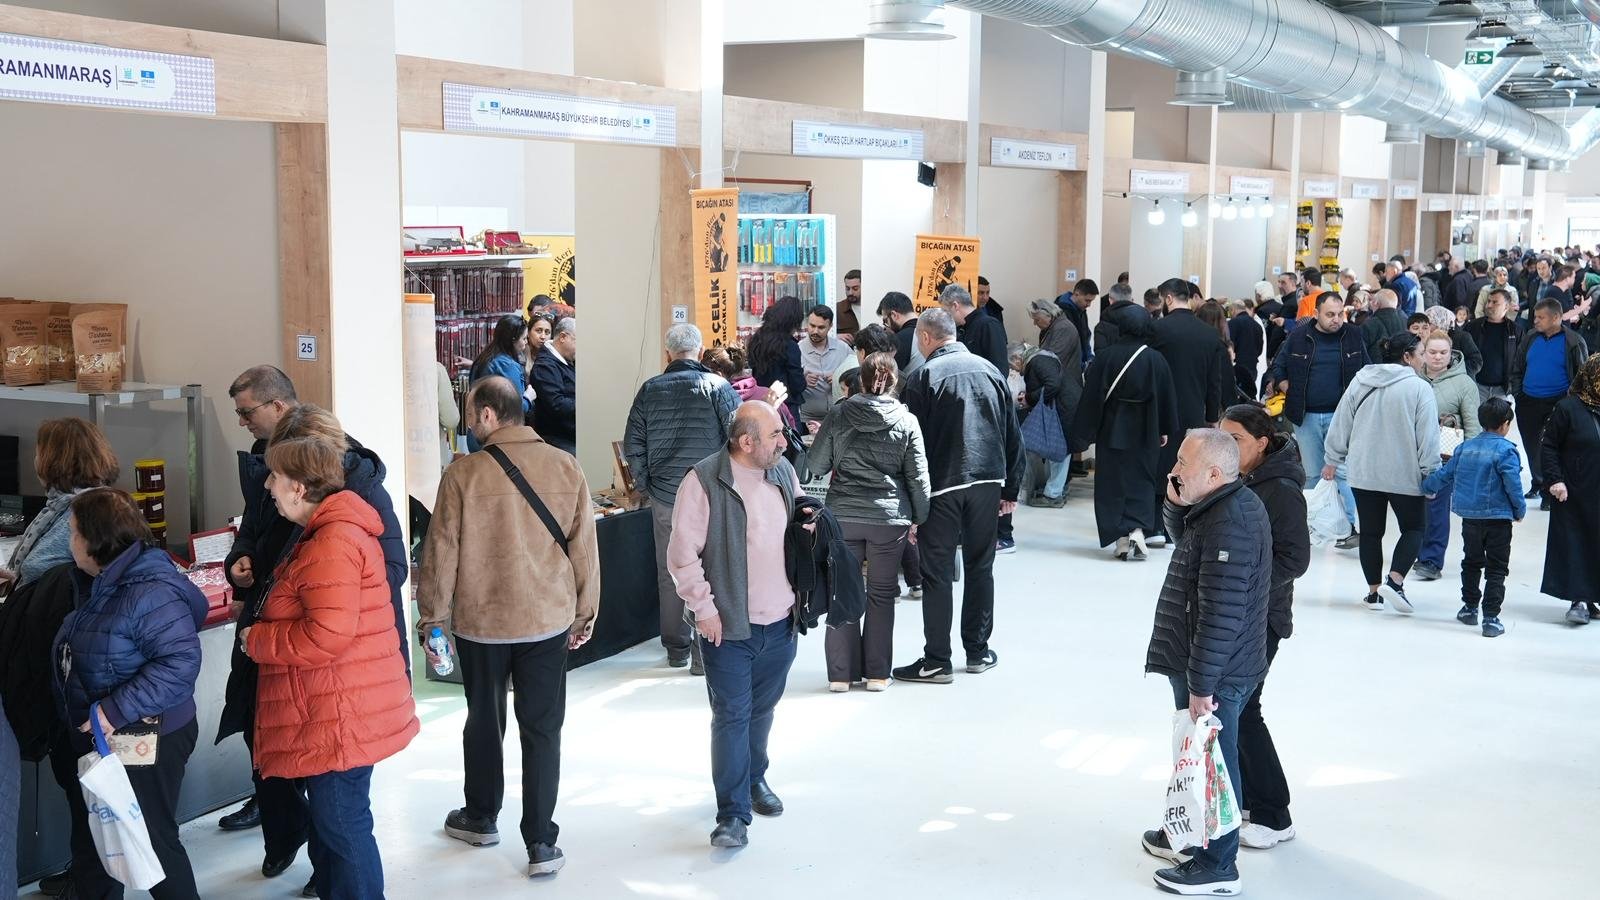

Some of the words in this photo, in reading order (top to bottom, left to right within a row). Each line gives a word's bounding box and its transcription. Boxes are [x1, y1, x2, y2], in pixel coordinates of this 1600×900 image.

[502, 106, 560, 122] KAHRAMANMARAŞ
[561, 112, 598, 125] BÜYÜKŞEHİR
[600, 116, 631, 128] BELEDİYESİ
[719, 199, 733, 208] ATASI
[921, 242, 951, 251] BIÇAĞIN
[709, 279, 722, 334] ÇELİK
[675, 310, 685, 319] 26
[301, 342, 313, 353] 25
